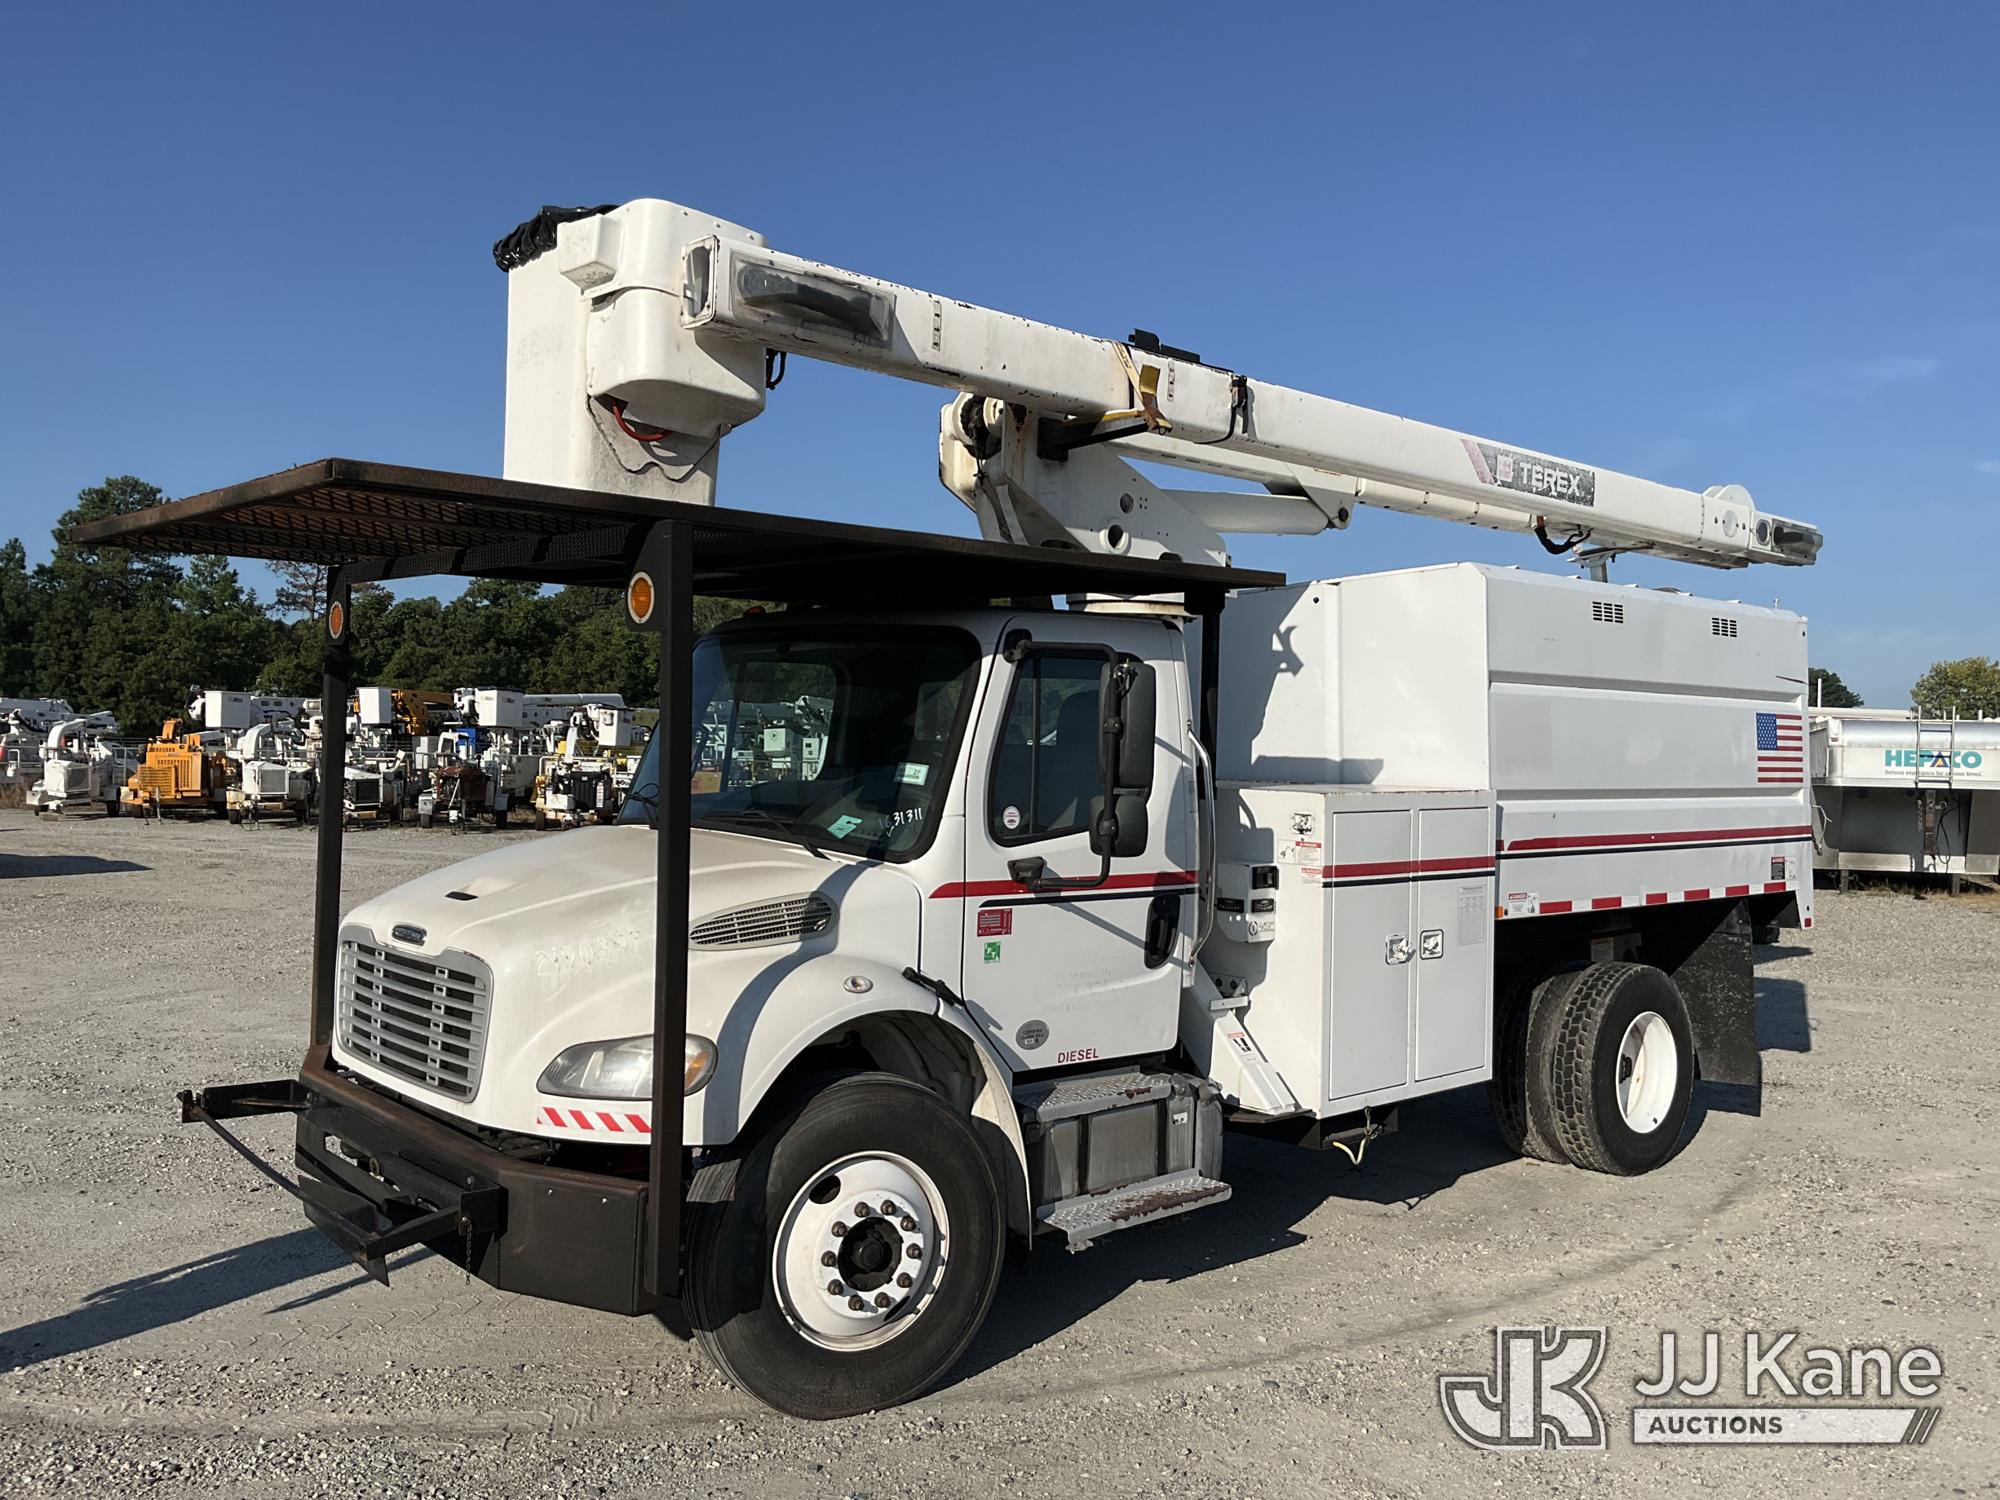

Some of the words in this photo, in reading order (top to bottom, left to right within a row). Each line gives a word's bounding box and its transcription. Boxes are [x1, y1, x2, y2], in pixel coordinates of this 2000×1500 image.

[1520, 462, 1580, 496] TEREX
[1885, 749, 1982, 768] HEPACO
[1057, 1048, 1099, 1063] DIESEL
